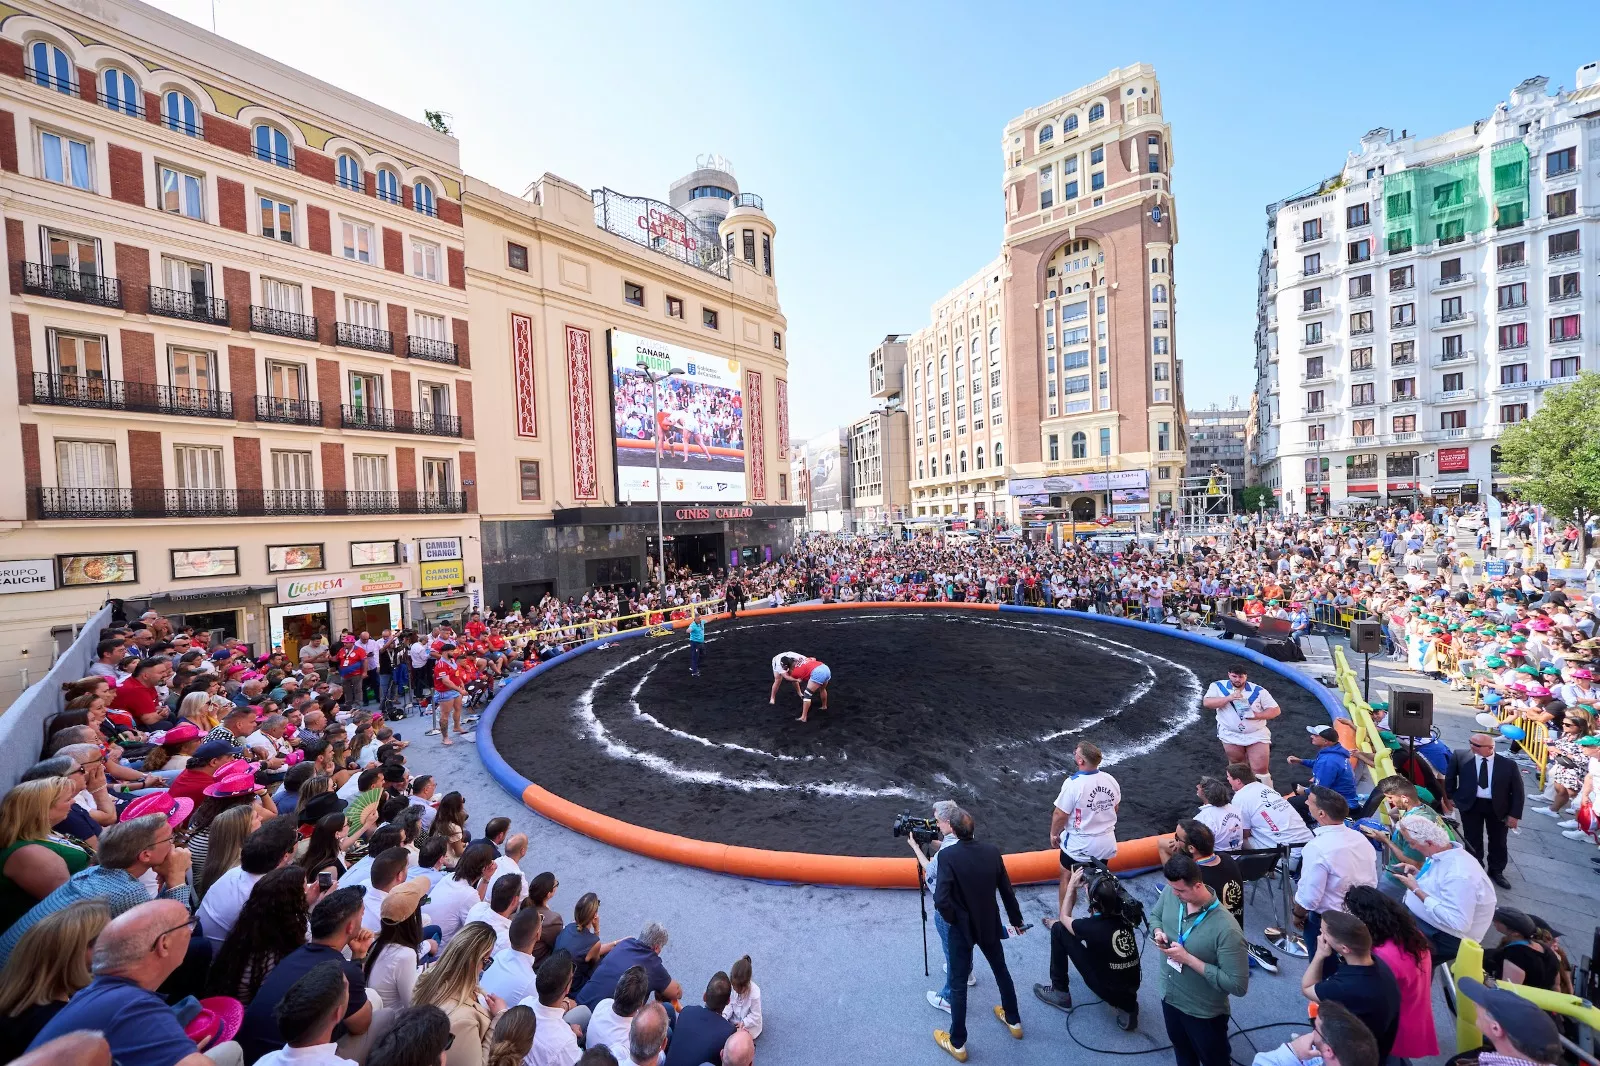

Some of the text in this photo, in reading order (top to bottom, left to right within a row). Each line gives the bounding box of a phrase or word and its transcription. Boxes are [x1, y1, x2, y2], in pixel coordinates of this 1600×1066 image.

[650, 208, 686, 232] CINES
[637, 215, 697, 251] CALLAO
[636, 346, 671, 360] CANARIA
[636, 353, 671, 372] MADRID
[1513, 376, 1580, 388] CONTINENTAL
[675, 507, 753, 520] CINES CALLAO
[425, 541, 456, 549] CAMBIO
[426, 549, 457, 558] CHANGE
[425, 567, 458, 575] CAMBIO
[425, 573, 460, 581] CHANGE
[287, 578, 343, 599] LIGERESA
[171, 590, 247, 601] EDIFICIO CALLAO
